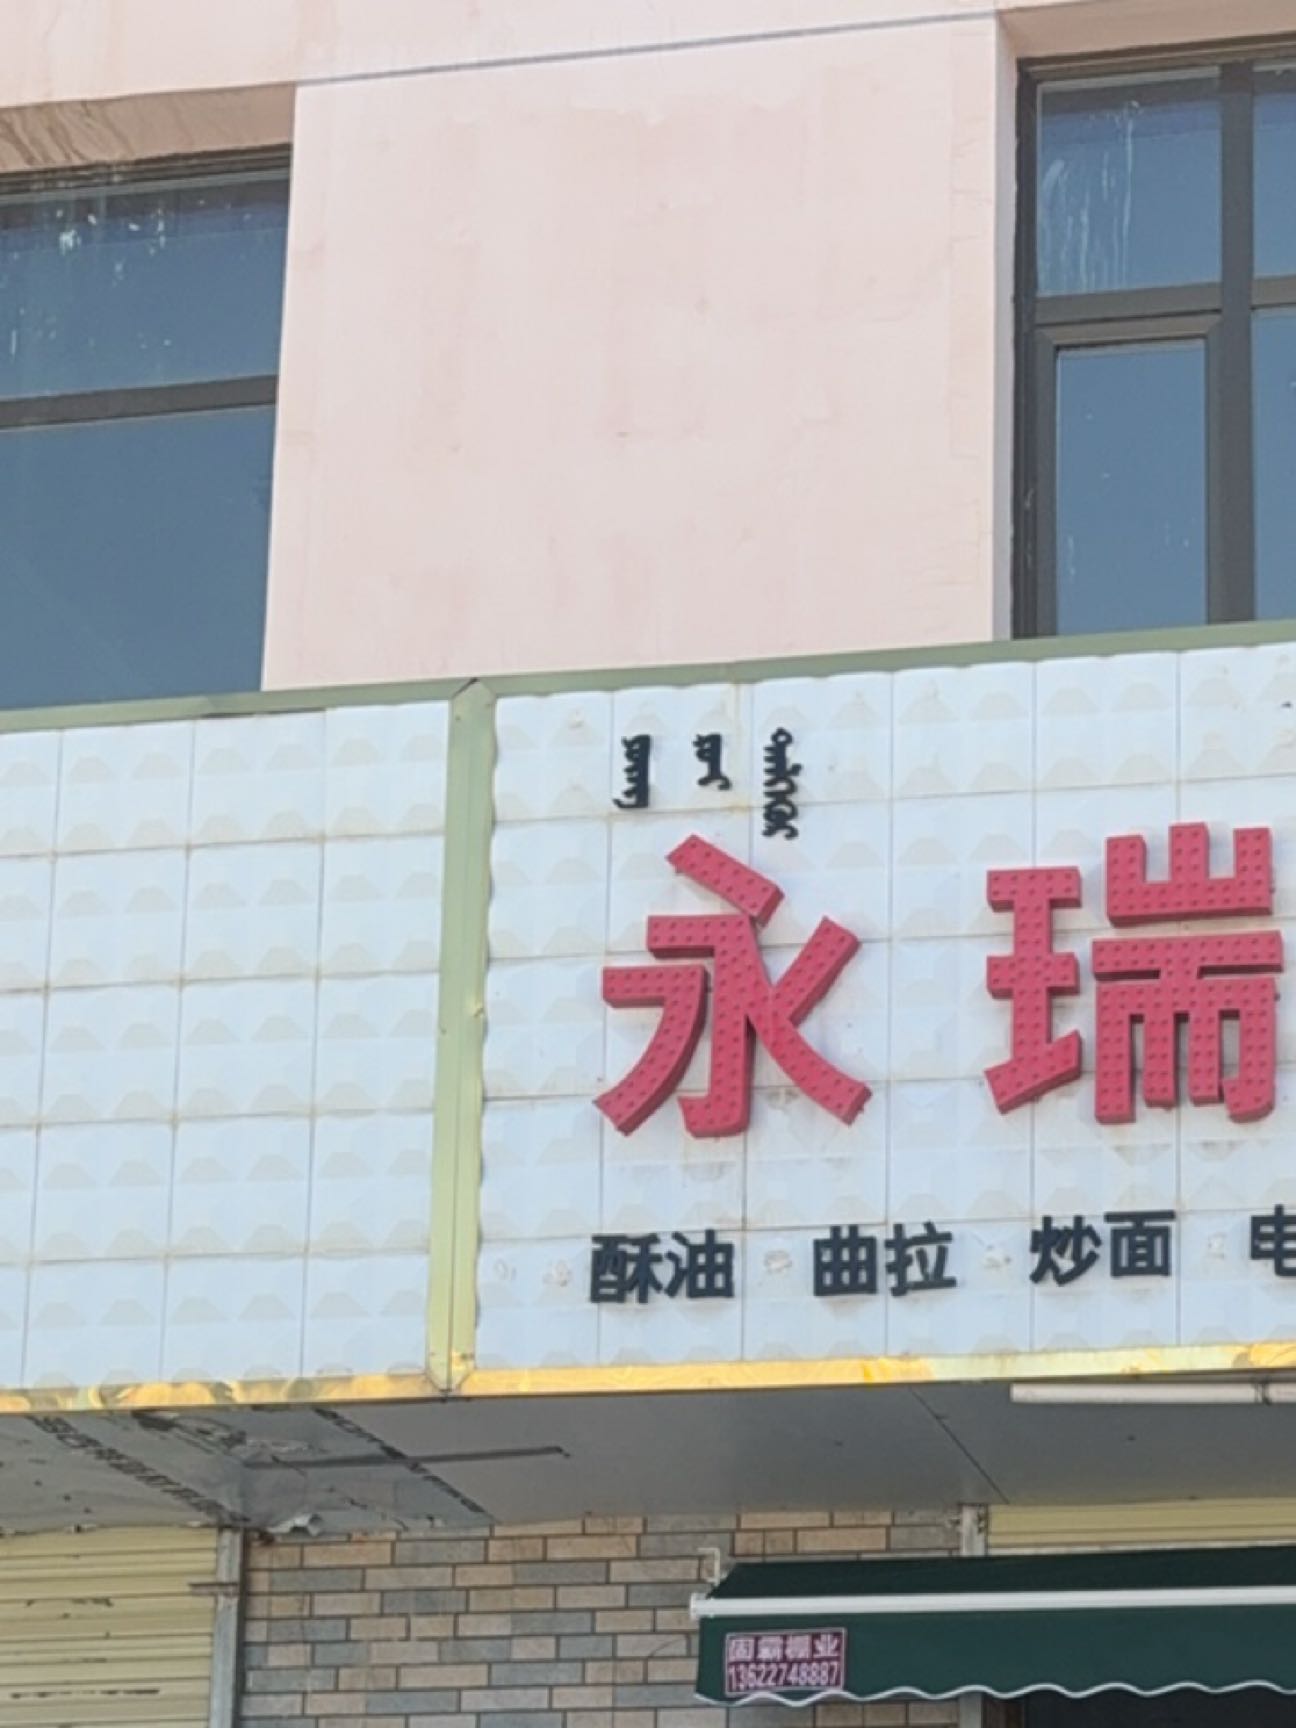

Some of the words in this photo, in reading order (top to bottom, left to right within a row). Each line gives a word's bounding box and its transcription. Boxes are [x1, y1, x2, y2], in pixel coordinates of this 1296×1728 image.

[590, 1229, 735, 1304] 酥油
[812, 1221, 957, 1297] 曲拉
[1029, 1209, 1177, 1287] 炒面
